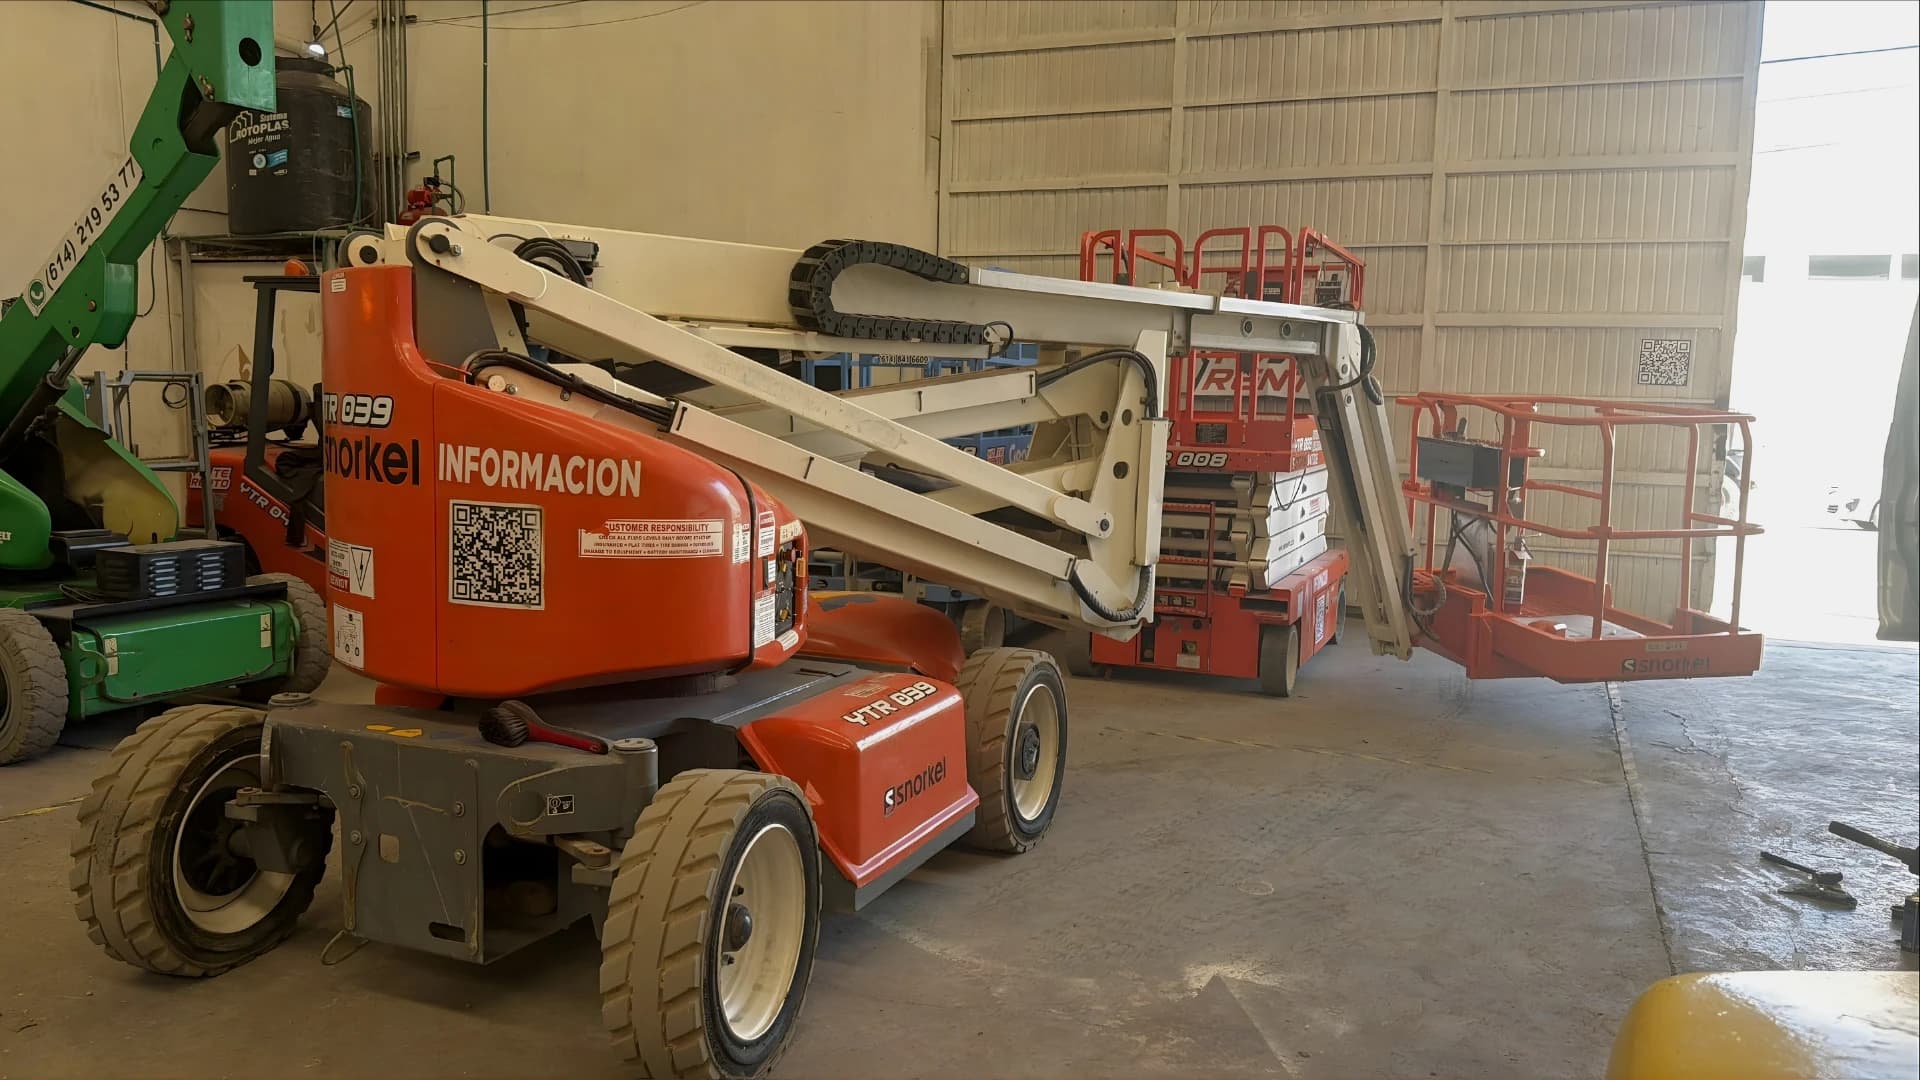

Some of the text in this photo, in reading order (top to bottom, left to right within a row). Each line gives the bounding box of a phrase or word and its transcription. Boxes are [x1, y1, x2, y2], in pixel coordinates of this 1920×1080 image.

[236, 120, 290, 139] ROTOPLAS
[45, 156, 136, 291] (614) 219 53 77
[323, 392, 394, 428] TR 039
[438, 442, 642, 498] INFORMACION
[1176, 451, 1228, 468] 008
[650, 522, 710, 532] RESPONSIBILITY
[841, 699, 899, 727] YTR
[888, 681, 938, 707] 039
[896, 755, 946, 807] snorkel
